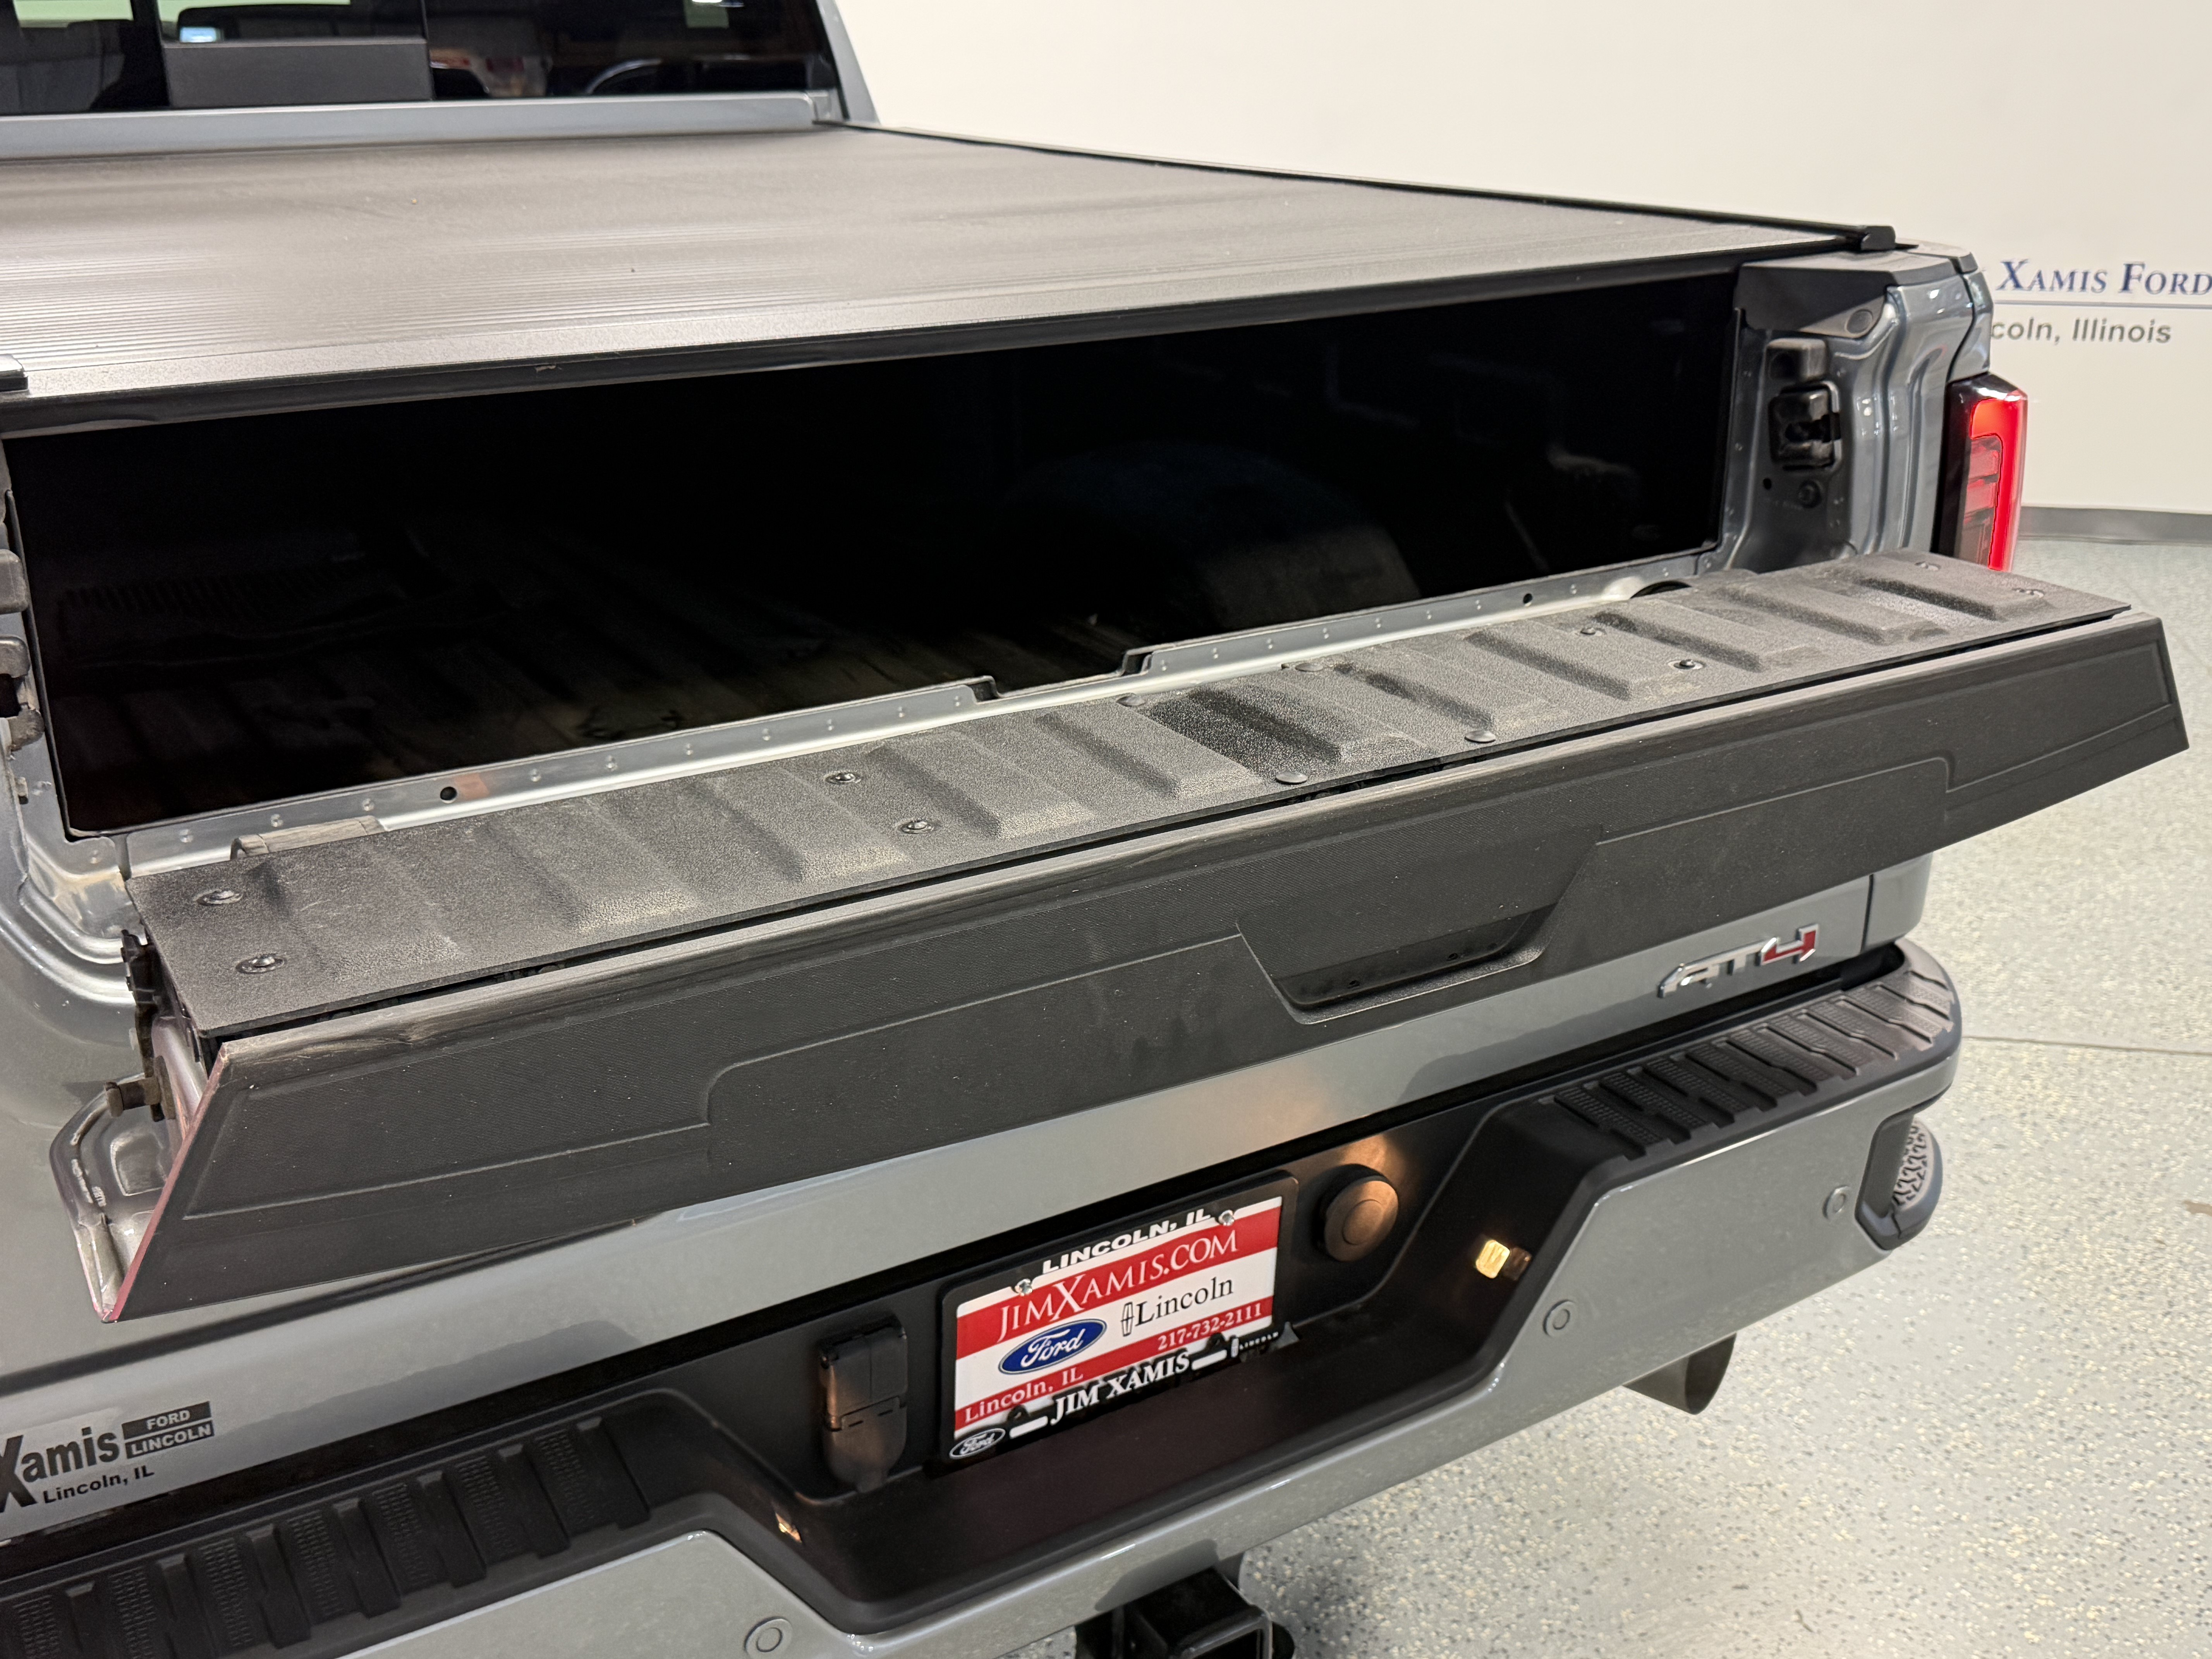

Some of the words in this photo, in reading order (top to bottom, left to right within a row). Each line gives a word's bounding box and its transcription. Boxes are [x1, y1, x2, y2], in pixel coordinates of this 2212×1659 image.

[2118, 261, 2212, 295] FORD
[1991, 317, 2061, 345] coln,
[2073, 319, 2172, 343] Illinois
[1658, 924, 1819, 998] AT4
[1042, 1220, 1177, 1274] LINCOLN,
[1186, 1208, 1211, 1225] IL
[1135, 1277, 1234, 1326] Lincoln
[1020, 1329, 1086, 1367] Ford
[1158, 1303, 1262, 1350] 217-732-2111
[965, 1381, 1054, 1423] Lincoln,
[1062, 1368, 1084, 1386] IL
[1050, 1386, 1099, 1425] JIM
[1105, 1352, 1190, 1396] XAMIS
[131, 1424, 212, 1455] LINCOLN
[146, 1410, 191, 1430] FORD
[43, 1473, 128, 1504] Lincoln,
[134, 1465, 155, 1480] IL
